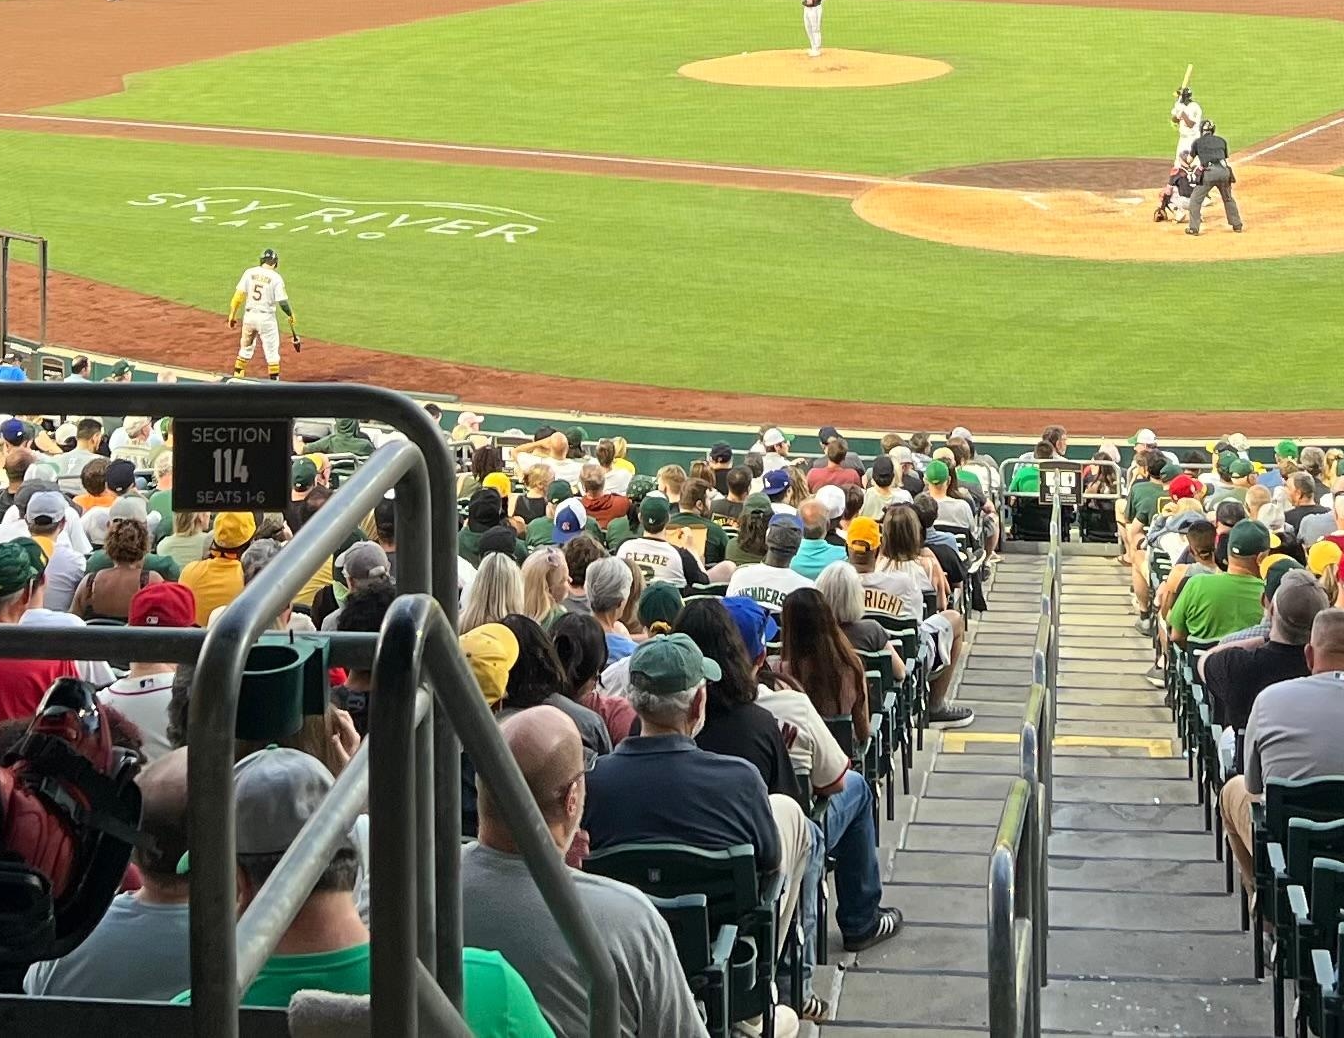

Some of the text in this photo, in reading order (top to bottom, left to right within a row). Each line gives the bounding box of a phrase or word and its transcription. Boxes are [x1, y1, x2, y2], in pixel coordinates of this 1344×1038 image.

[127, 192, 539, 243] SKY RIVER
[189, 215, 388, 240] CASINO
[252, 284, 263, 301] 5
[191, 427, 271, 443] SECTION
[212, 448, 249, 484] 114
[196, 490, 266, 504] SEATS 1-6
[624, 552, 670, 567] CLARE
[737, 587, 787, 607] HENDERS
[864, 589, 905, 616] RIGHT
